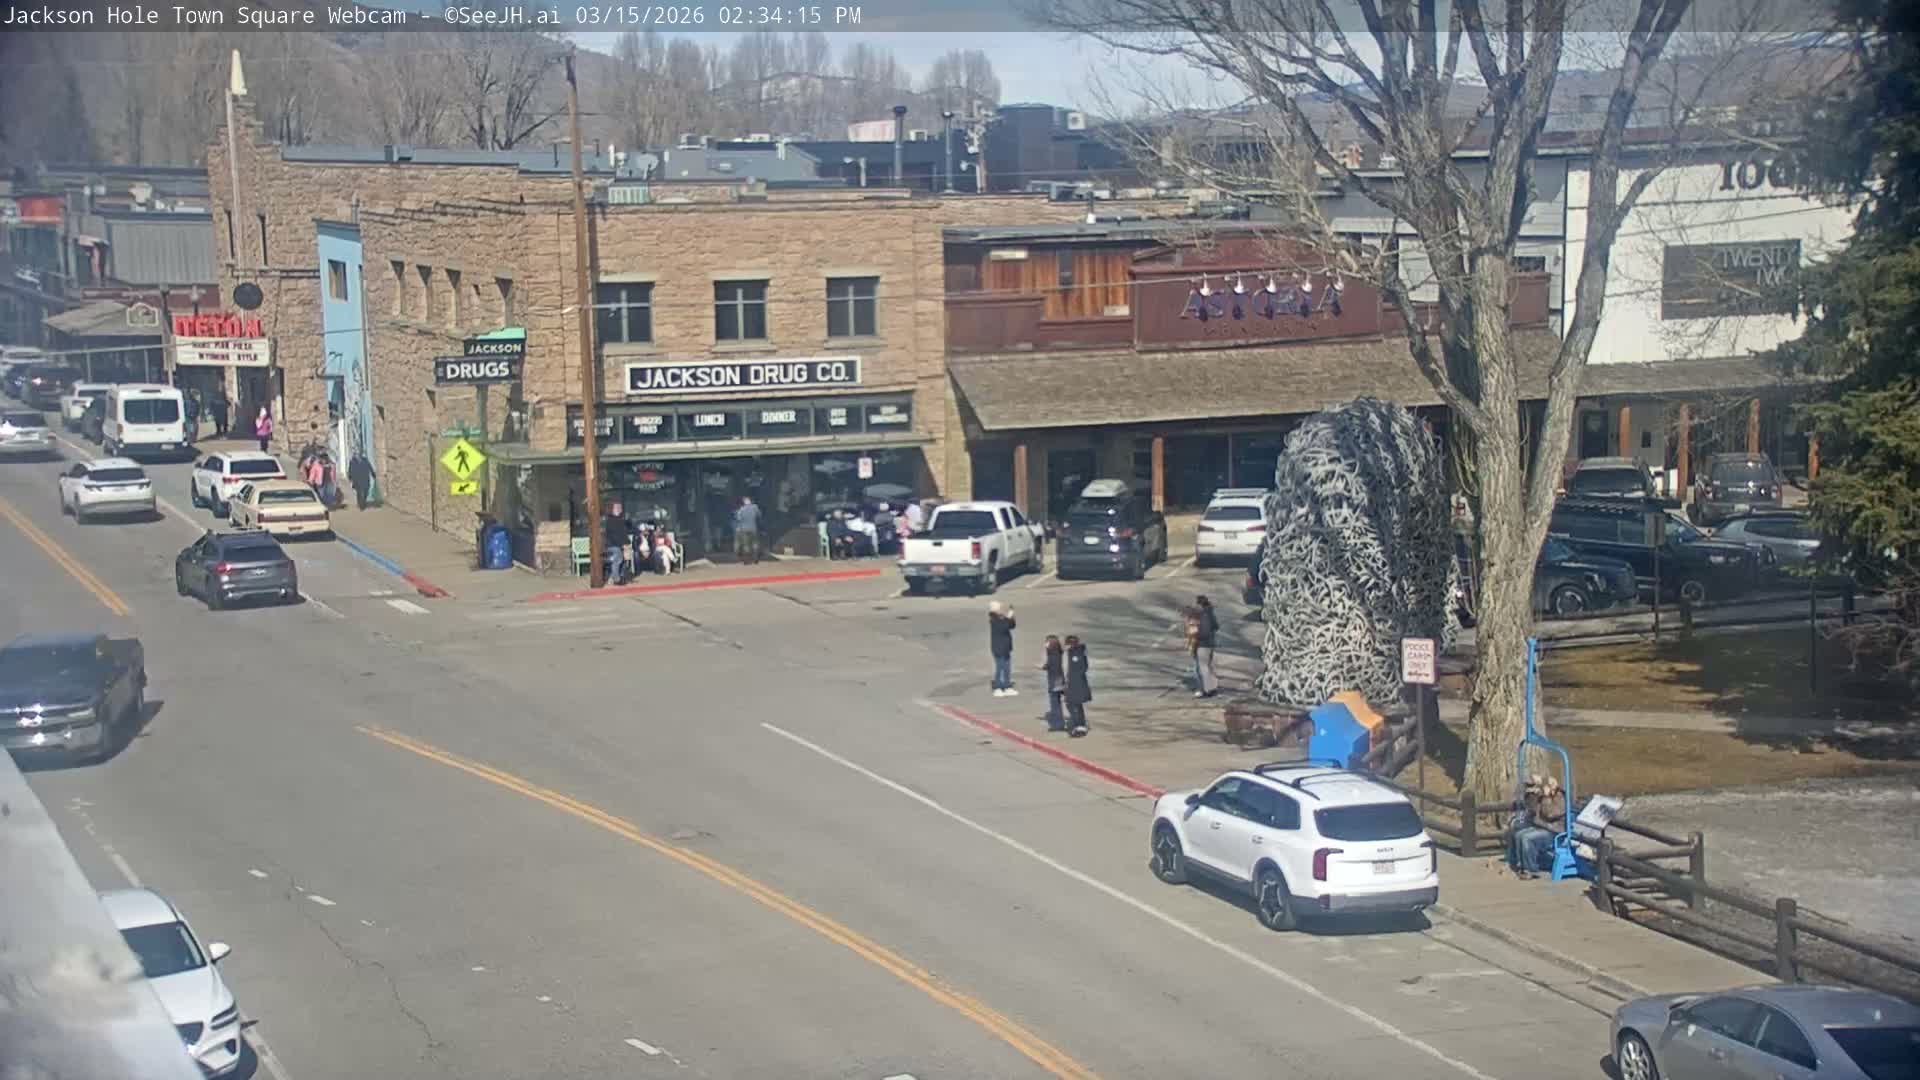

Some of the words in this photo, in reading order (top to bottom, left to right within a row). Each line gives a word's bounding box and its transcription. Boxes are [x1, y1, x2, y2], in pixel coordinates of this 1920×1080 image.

[1719, 246, 1794, 268] TWENTY
[178, 316, 262, 337] TETON
[468, 343, 522, 355] JACKSON
[446, 361, 510, 380] DRUGS
[637, 366, 741, 388] JACKSON
[750, 363, 808, 384] DRUG
[816, 362, 850, 382] CO.
[694, 412, 726, 426] LUNCH
[761, 410, 797, 425] DINNER
